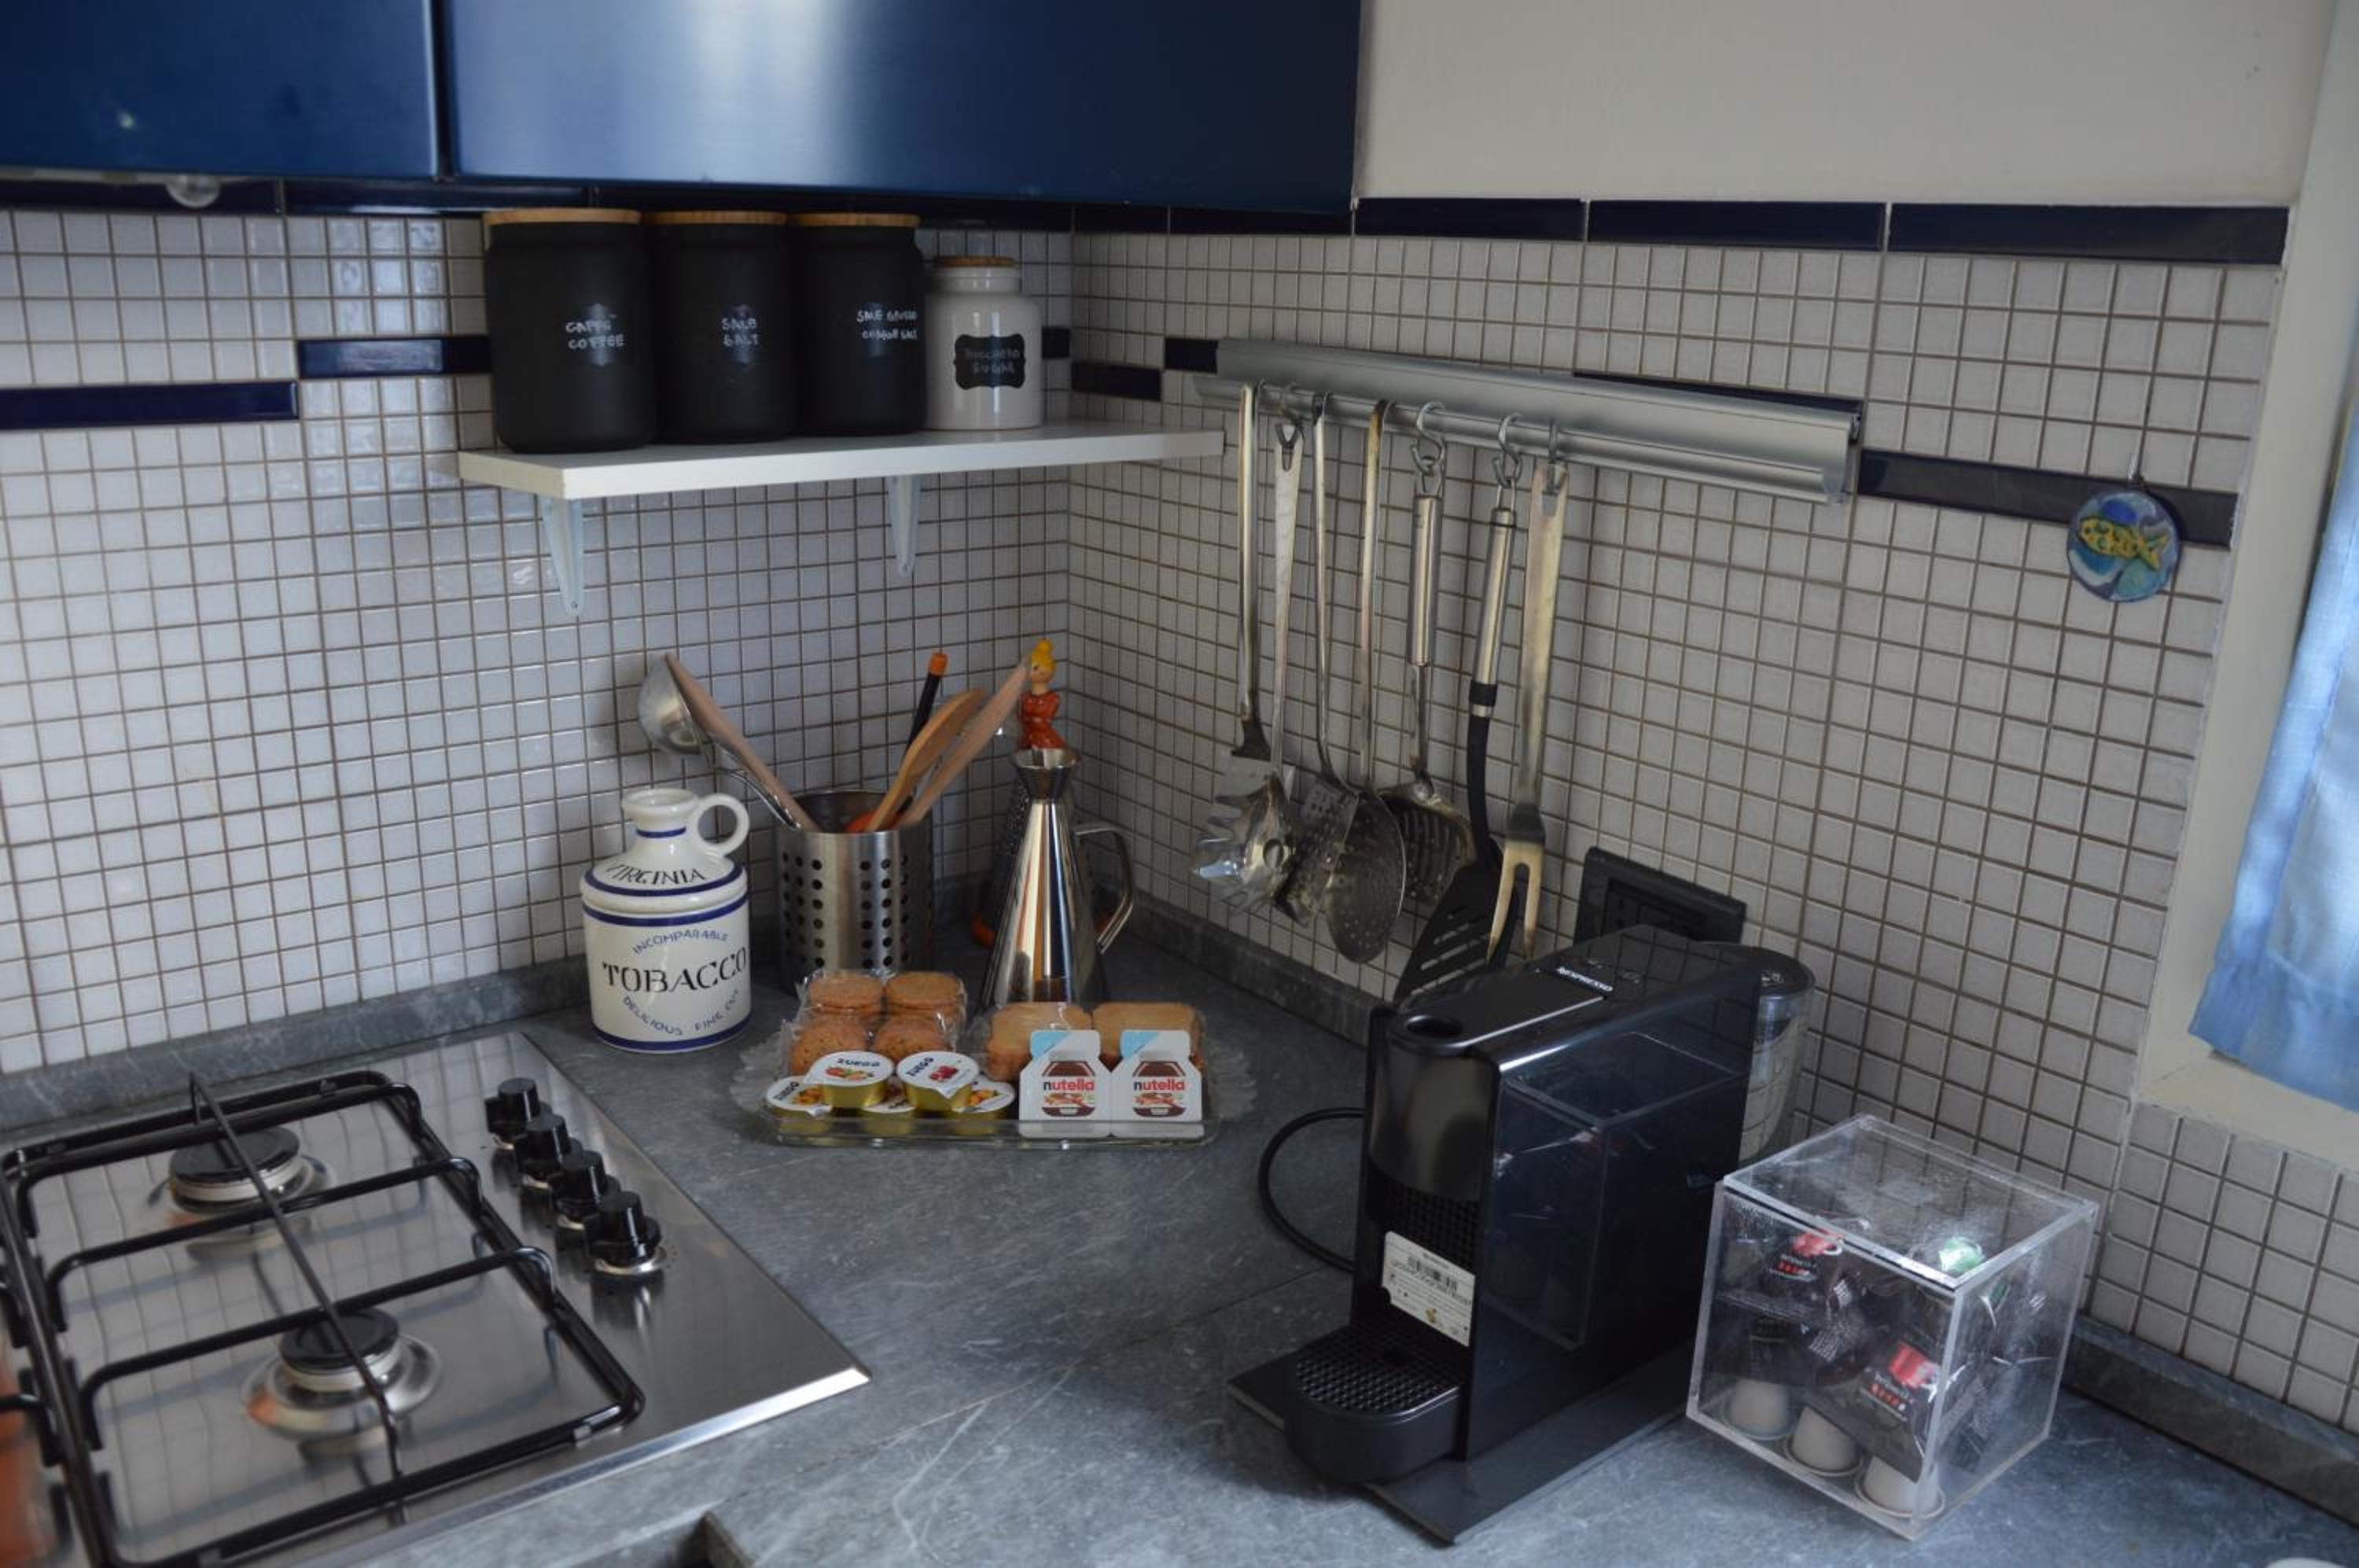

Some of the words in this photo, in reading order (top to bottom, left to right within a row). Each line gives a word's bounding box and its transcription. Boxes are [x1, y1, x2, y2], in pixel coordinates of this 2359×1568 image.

[568, 333, 624, 350] COFFEE
[605, 864, 706, 885] VIRGINIA
[632, 929, 729, 955] INCOMPARABLE
[602, 946, 748, 993] TOBACCO
[623, 996, 683, 1036] DELICIOUS
[1043, 1078, 1095, 1091] nutella
[1133, 1078, 1185, 1091] nutella
